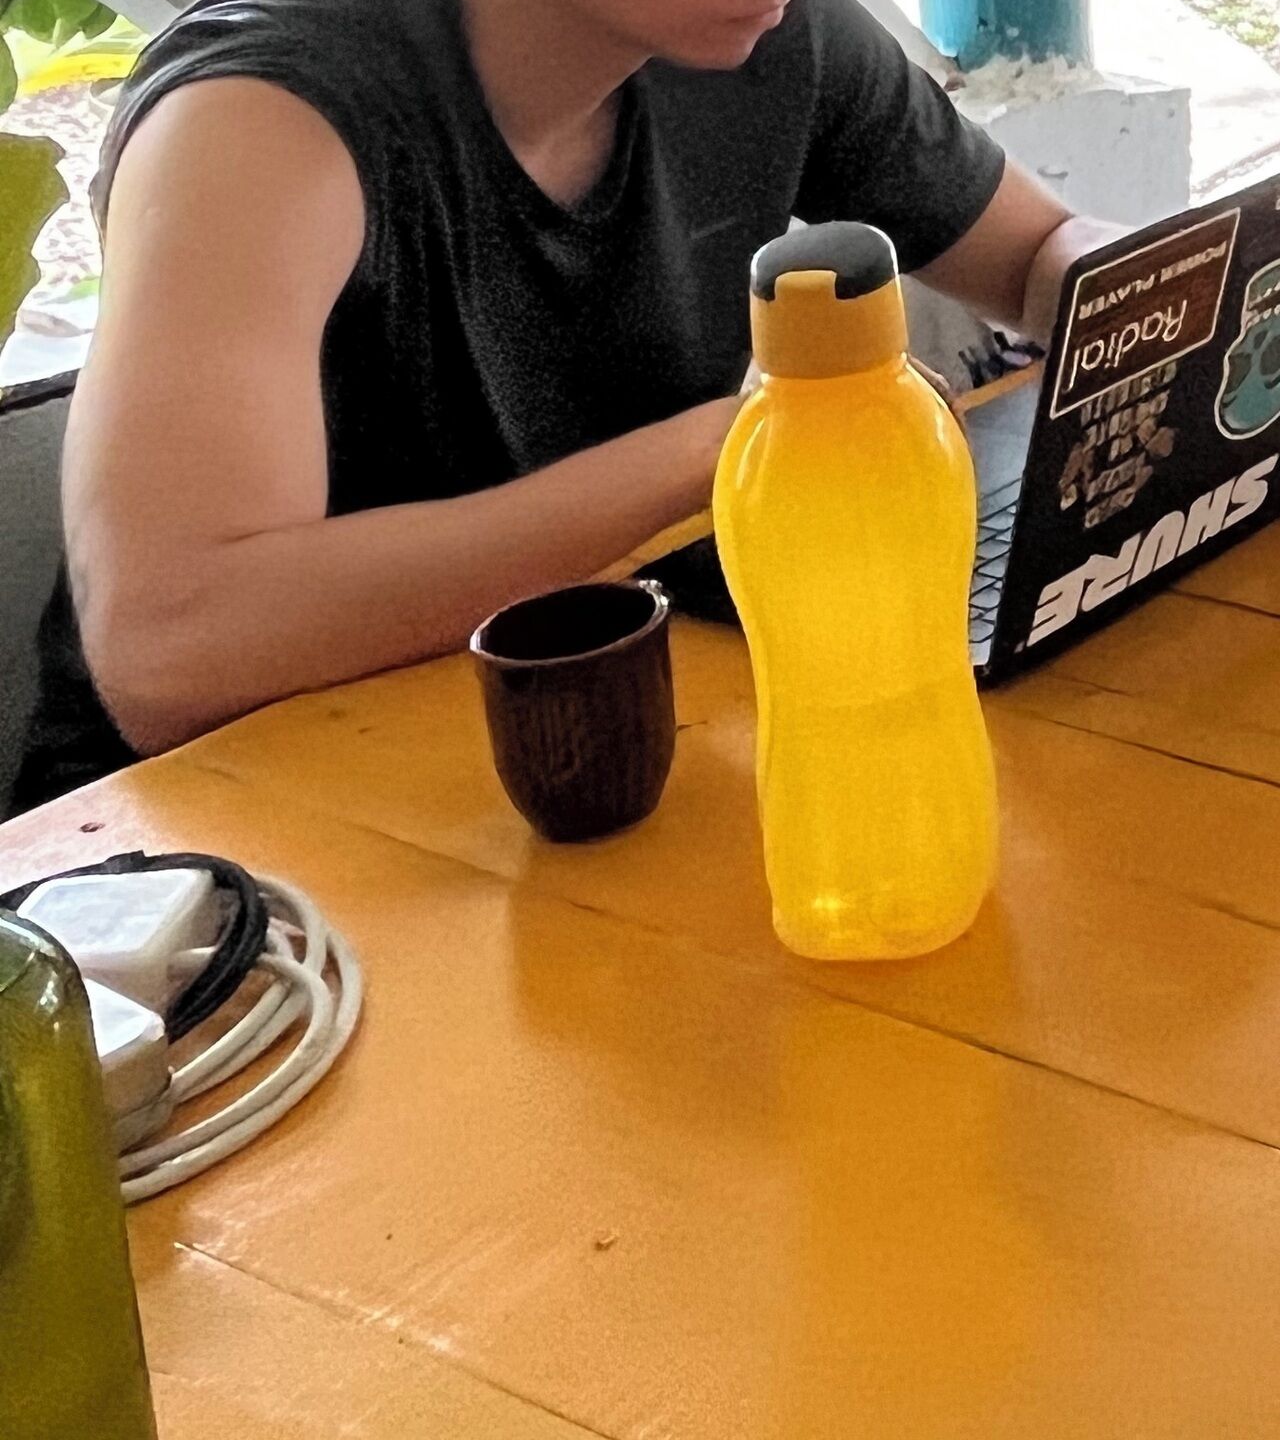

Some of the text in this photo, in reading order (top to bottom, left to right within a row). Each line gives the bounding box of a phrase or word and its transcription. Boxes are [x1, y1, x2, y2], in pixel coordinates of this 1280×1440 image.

[1078, 273, 1156, 321] PLAYER
[1062, 299, 1188, 393] Radial
[1027, 453, 1280, 648] SHURE
